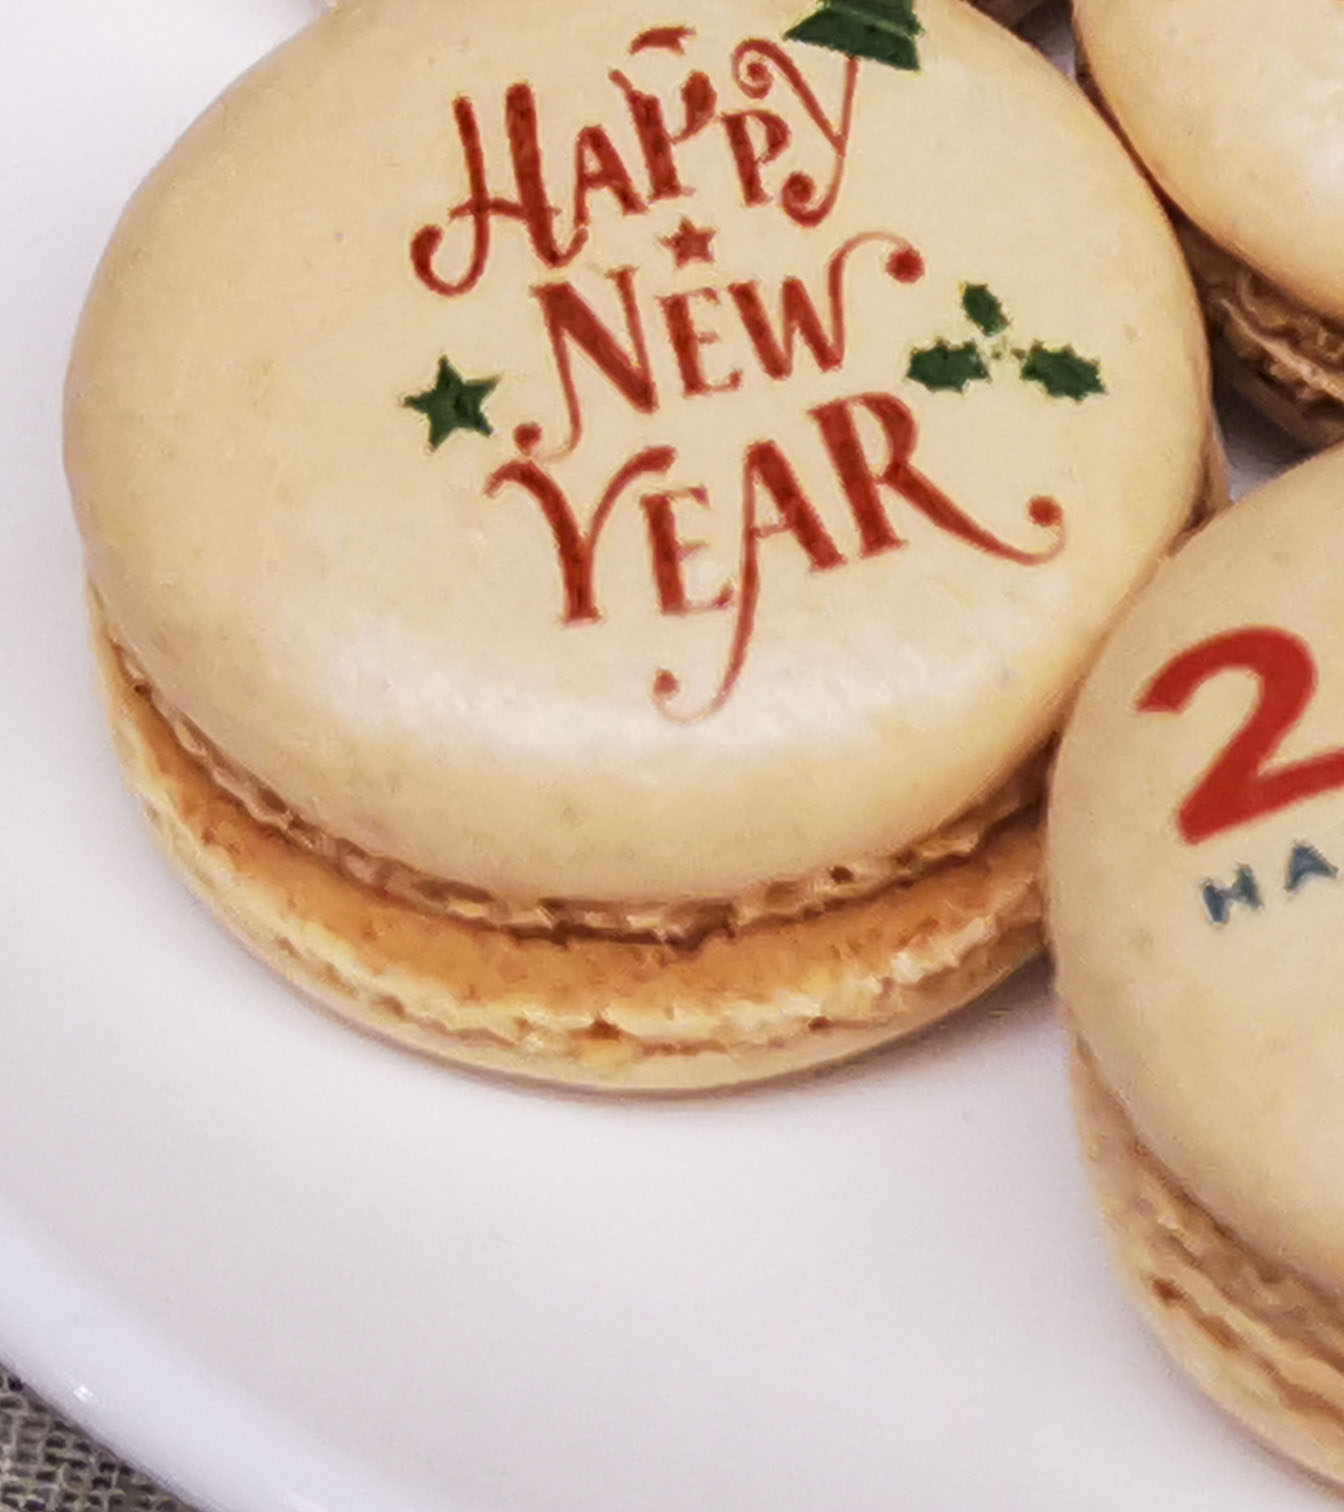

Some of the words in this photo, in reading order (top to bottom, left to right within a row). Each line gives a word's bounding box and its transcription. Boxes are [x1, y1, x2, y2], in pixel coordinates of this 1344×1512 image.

[409, 24, 861, 297] HAPPY
[512, 229, 926, 462] NEW
[483, 392, 1067, 725] YEAR
